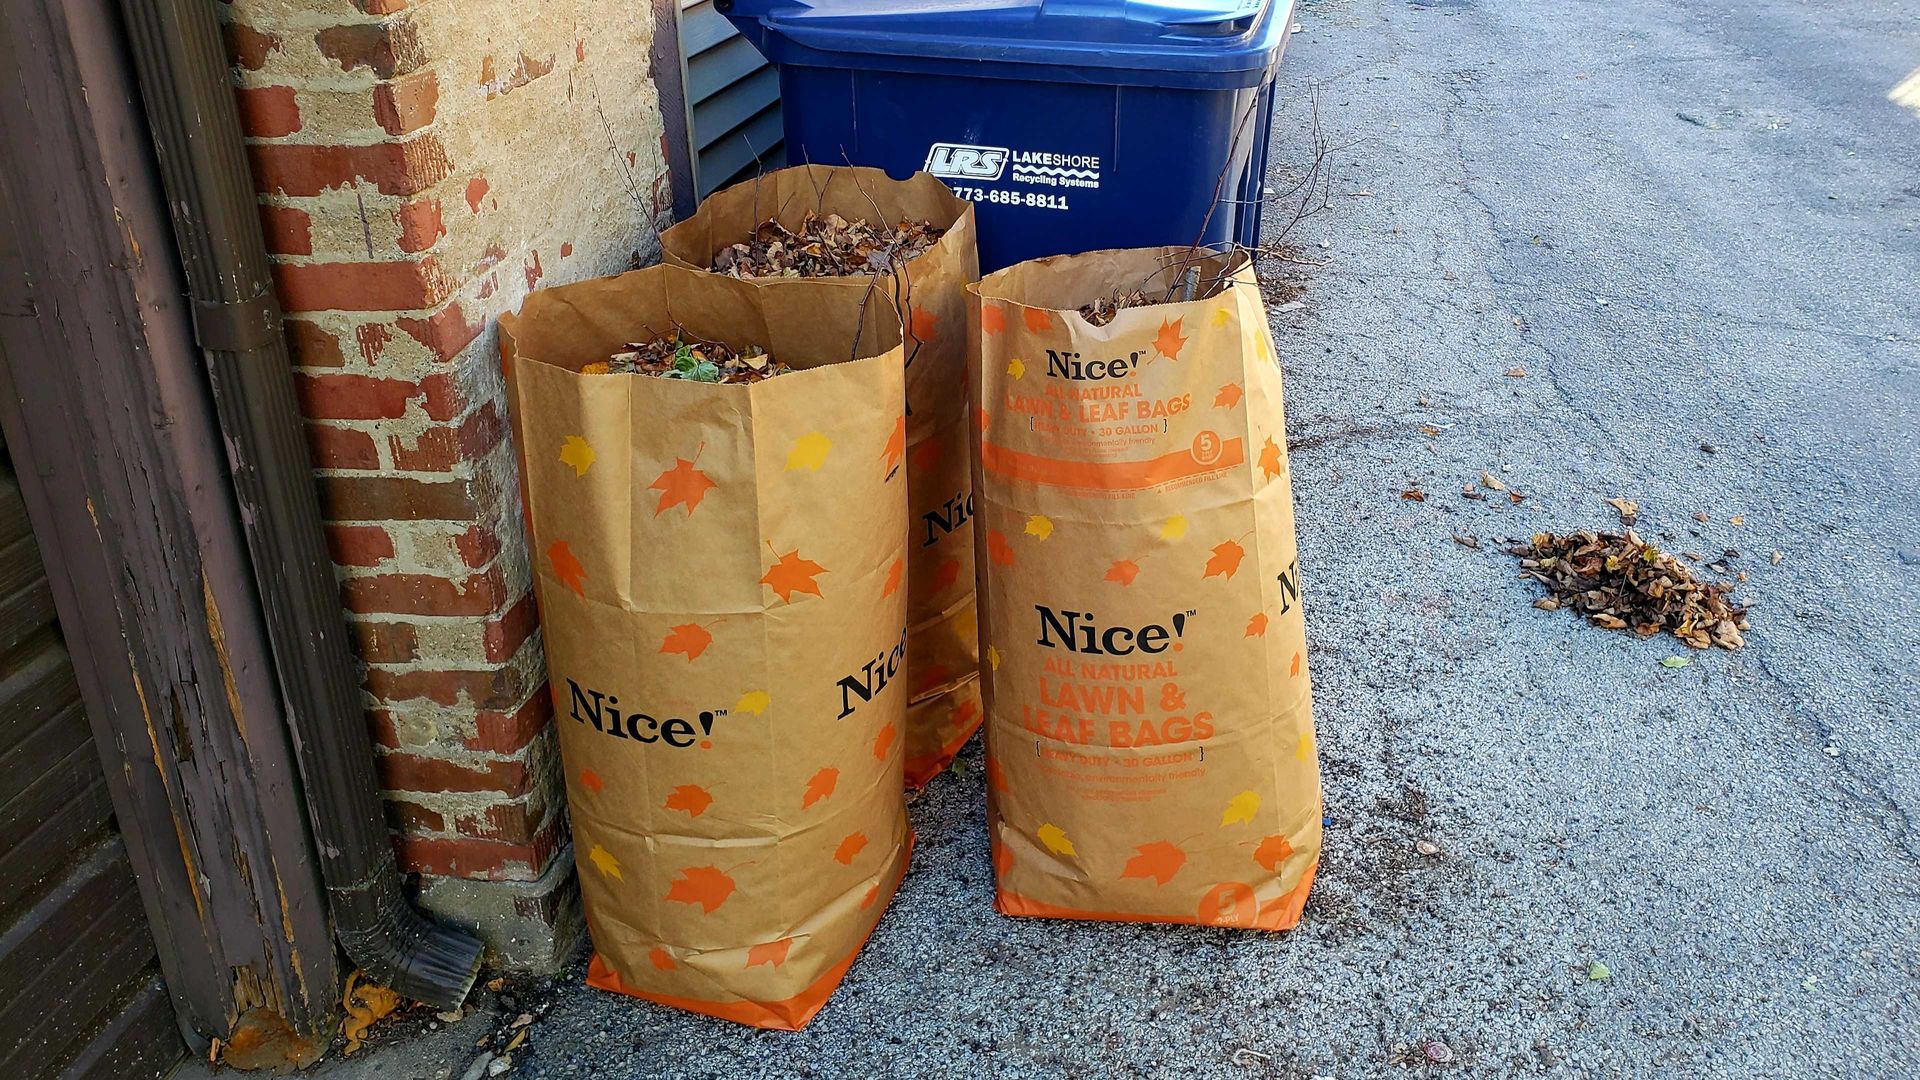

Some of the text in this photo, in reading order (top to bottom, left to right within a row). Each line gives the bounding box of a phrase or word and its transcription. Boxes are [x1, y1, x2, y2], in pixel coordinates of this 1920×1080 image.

[929, 147, 1003, 175] LRS
[1012, 150, 1100, 169] LAKESHORE
[1012, 172, 1100, 189] Recycling Systems
[952, 186, 1069, 210] 773-685-8811
[1069, 383, 1143, 401] NATURAL
[1079, 400, 1129, 423] LEAF
[1136, 392, 1191, 420] BAGS
[1099, 426, 1112, 437] 30
[1115, 423, 1159, 436] GALLON
[1200, 433, 1212, 451] 5
[1043, 657, 1179, 681] ALL NATURAL
[1040, 676, 1187, 716] LAWN &
[1022, 704, 1216, 749] LEAF BAGS
[1143, 752, 1195, 768] GALLON
